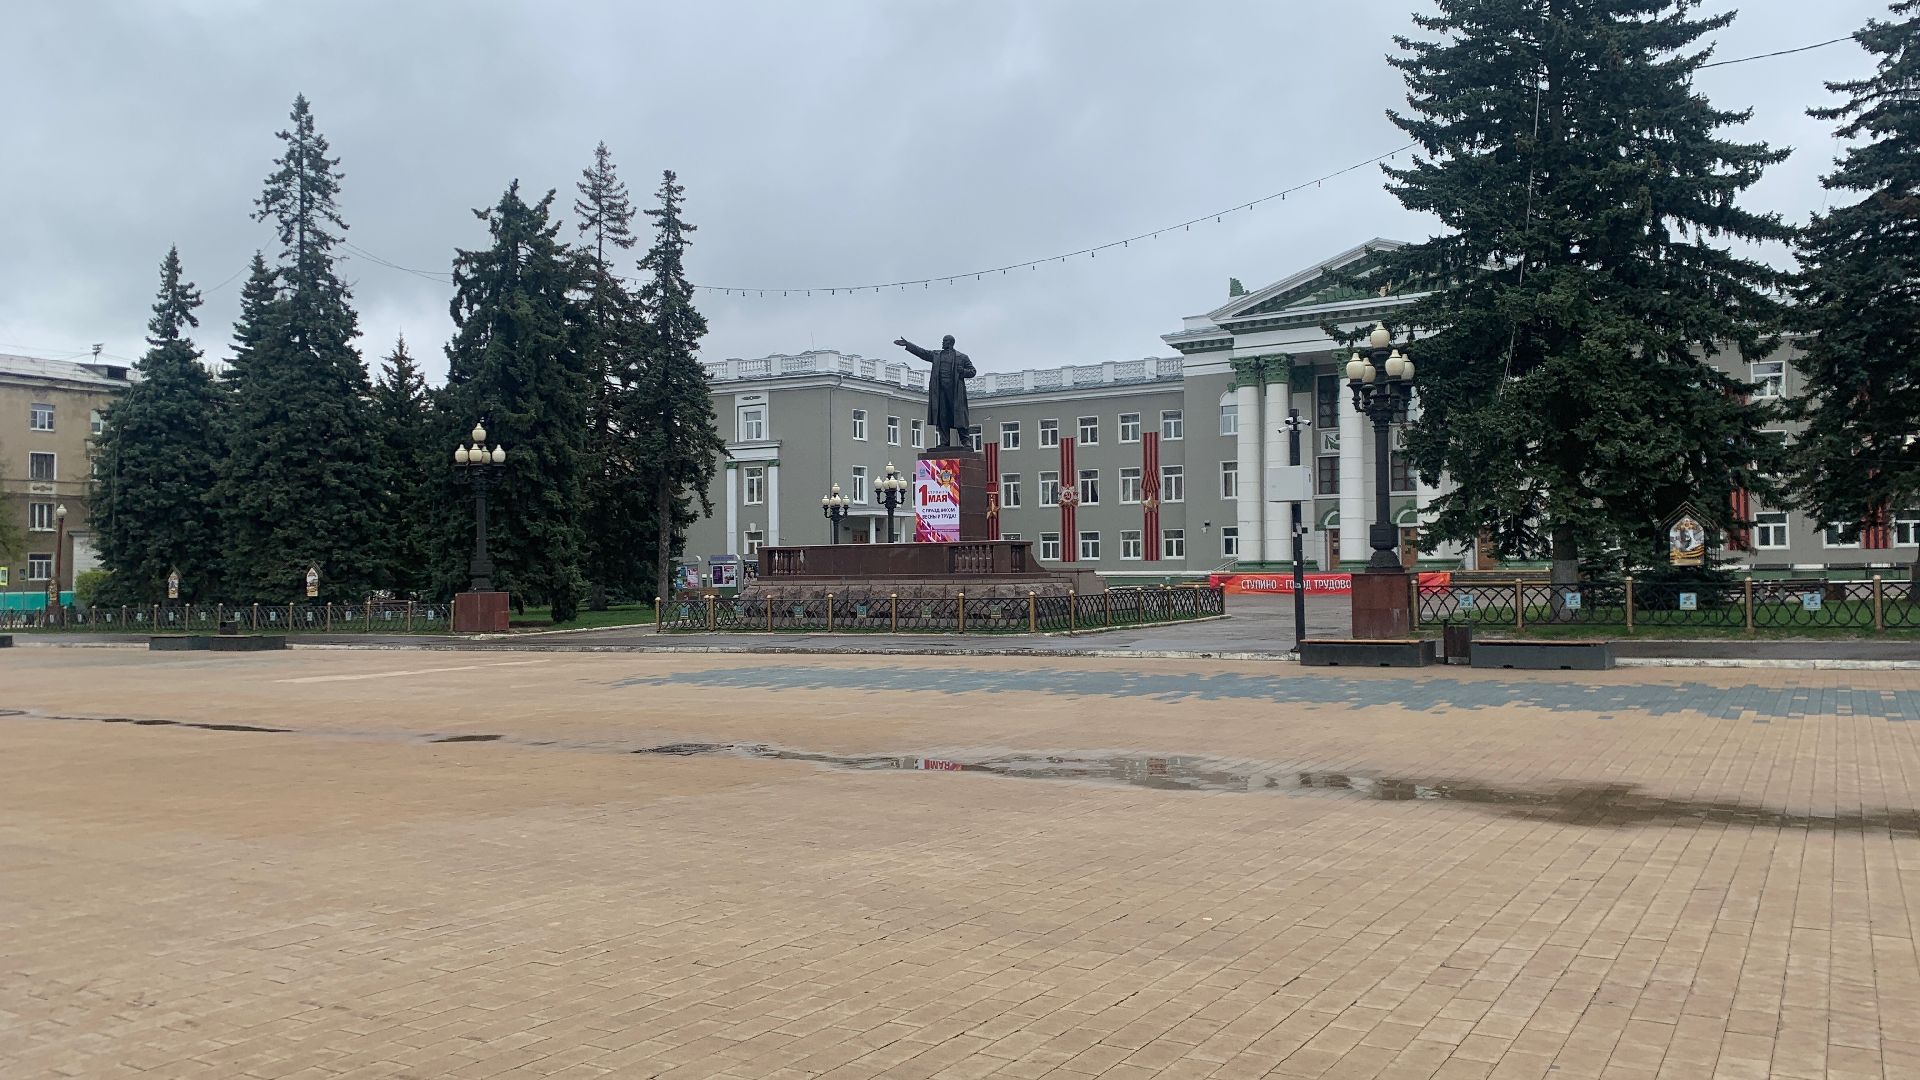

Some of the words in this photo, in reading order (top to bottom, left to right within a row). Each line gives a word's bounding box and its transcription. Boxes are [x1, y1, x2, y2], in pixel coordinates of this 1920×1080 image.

[919, 485, 927, 506] 1
[928, 495, 948, 503] МАЯ
[1241, 579, 1277, 590] СТУПИНО
